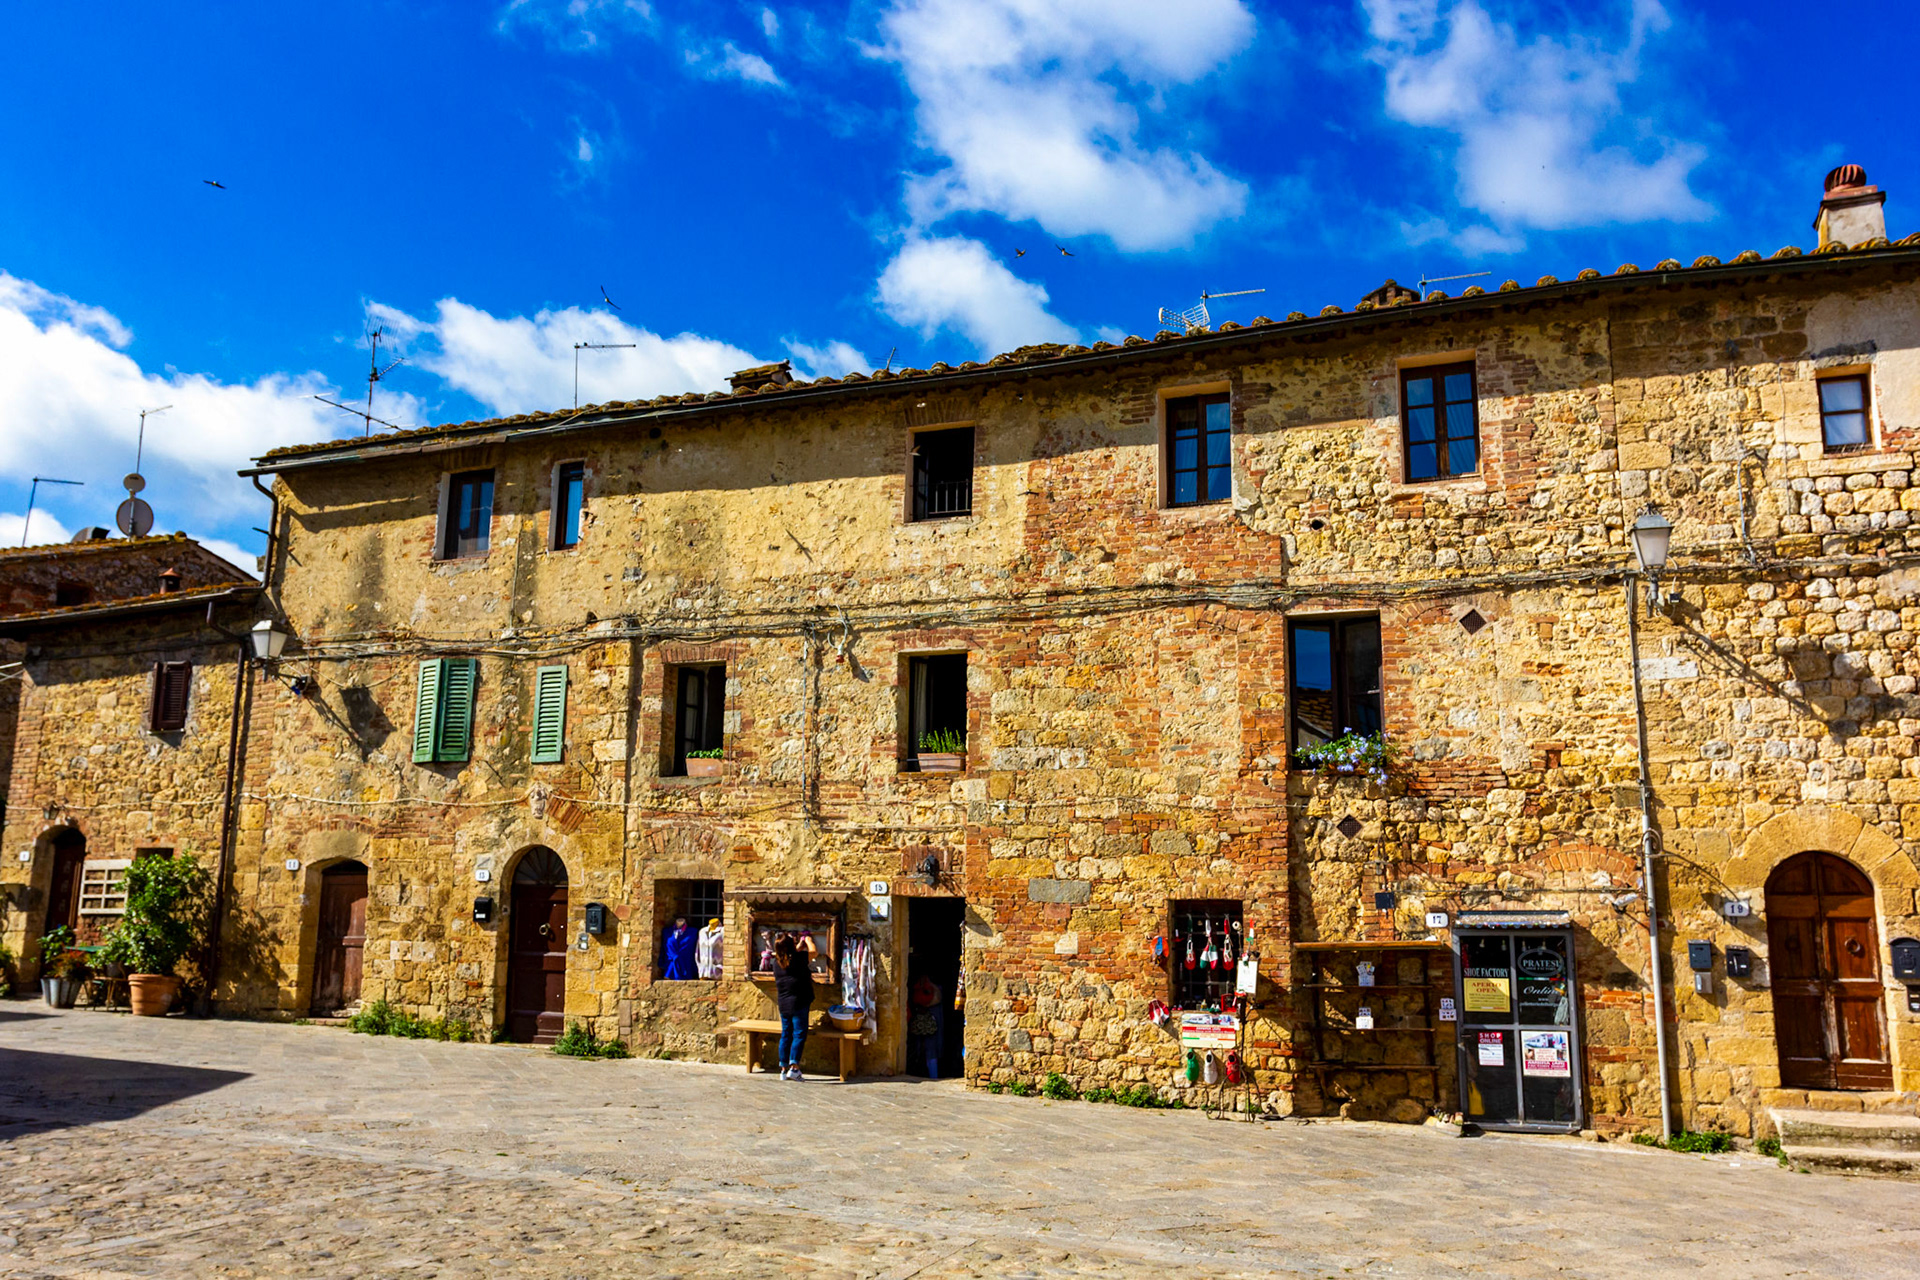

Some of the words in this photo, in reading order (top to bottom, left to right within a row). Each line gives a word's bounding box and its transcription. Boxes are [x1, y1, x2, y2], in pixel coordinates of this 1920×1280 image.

[874, 884, 883, 892] 15
[1731, 904, 1743, 914] 19
[1432, 915, 1442, 924] 17
[1522, 959, 1560, 967] PRATESI
[1463, 967, 1480, 977] SHOE
[1481, 967, 1509, 978] FACTORY
